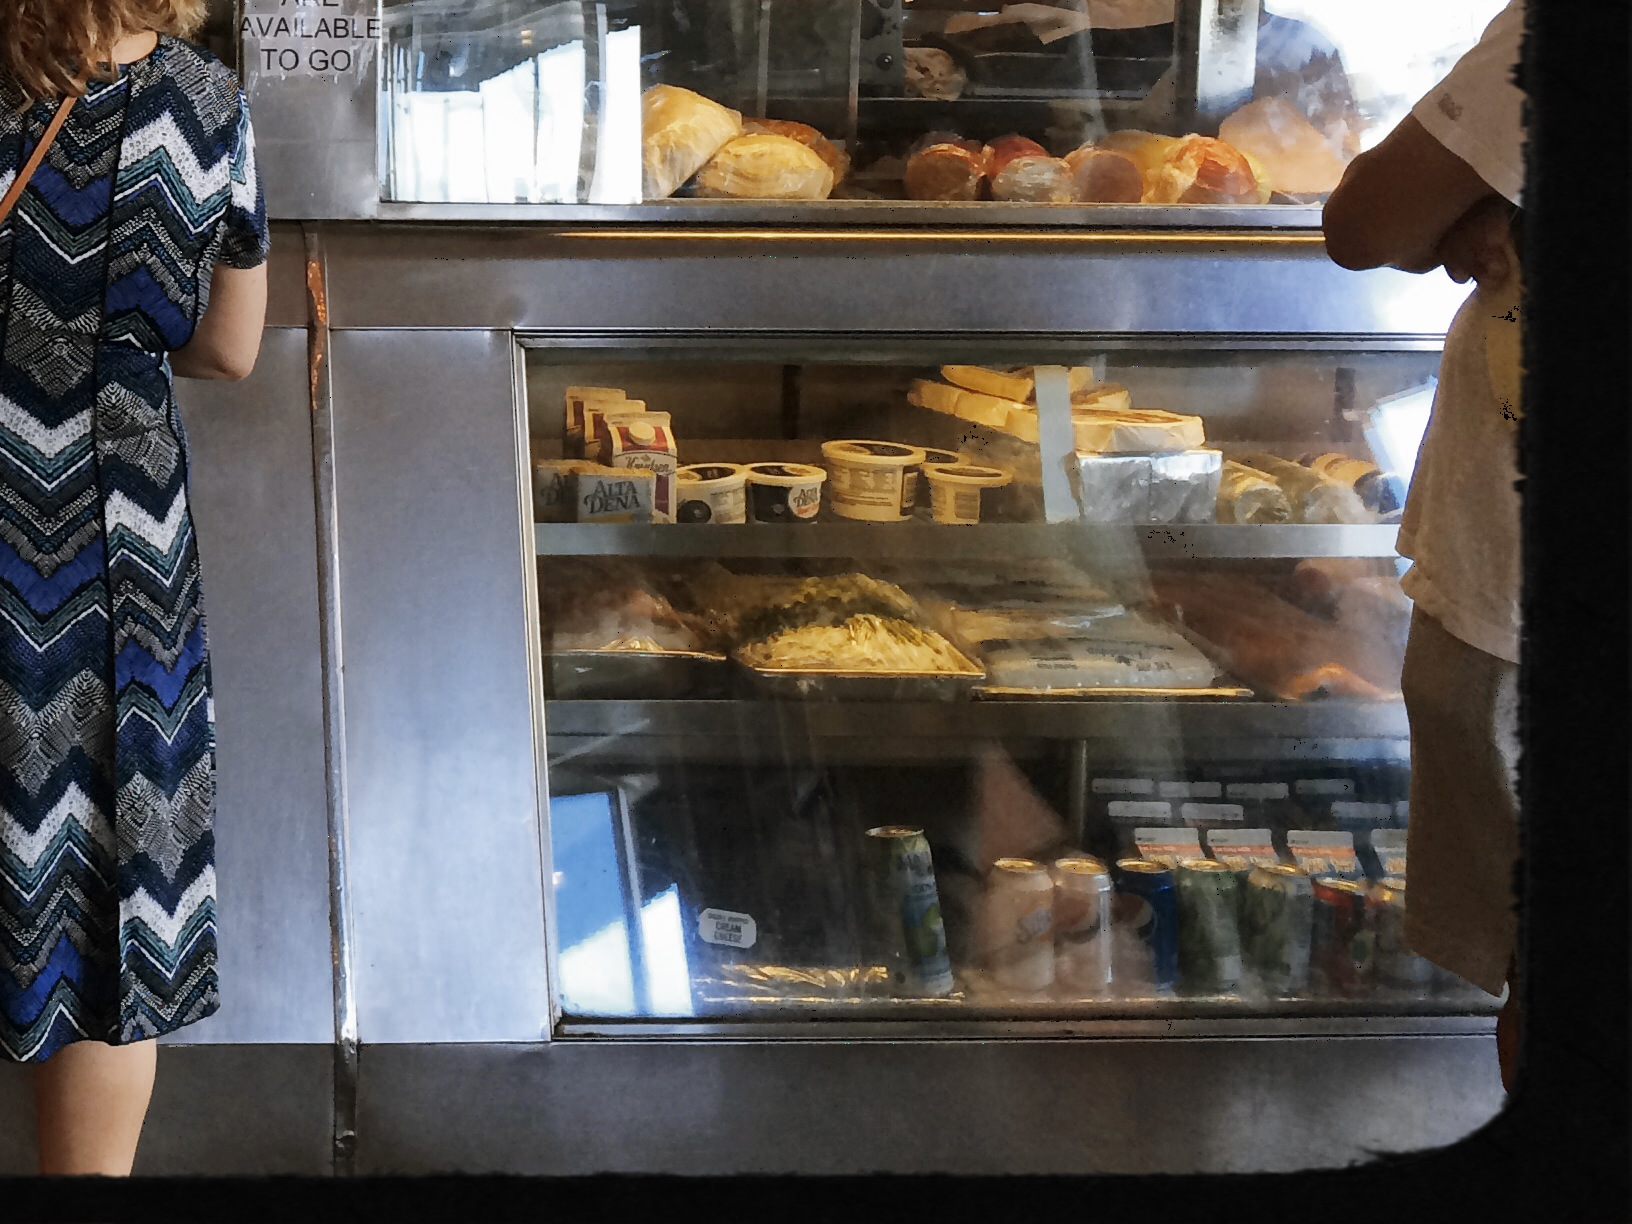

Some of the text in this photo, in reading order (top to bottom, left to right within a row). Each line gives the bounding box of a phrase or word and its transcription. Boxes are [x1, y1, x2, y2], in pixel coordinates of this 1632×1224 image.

[241, 17, 381, 39] AVAILABLE
[261, 49, 351, 71] TO GO
[594, 480, 636, 496] ALTA
[583, 493, 640, 513] DENA
